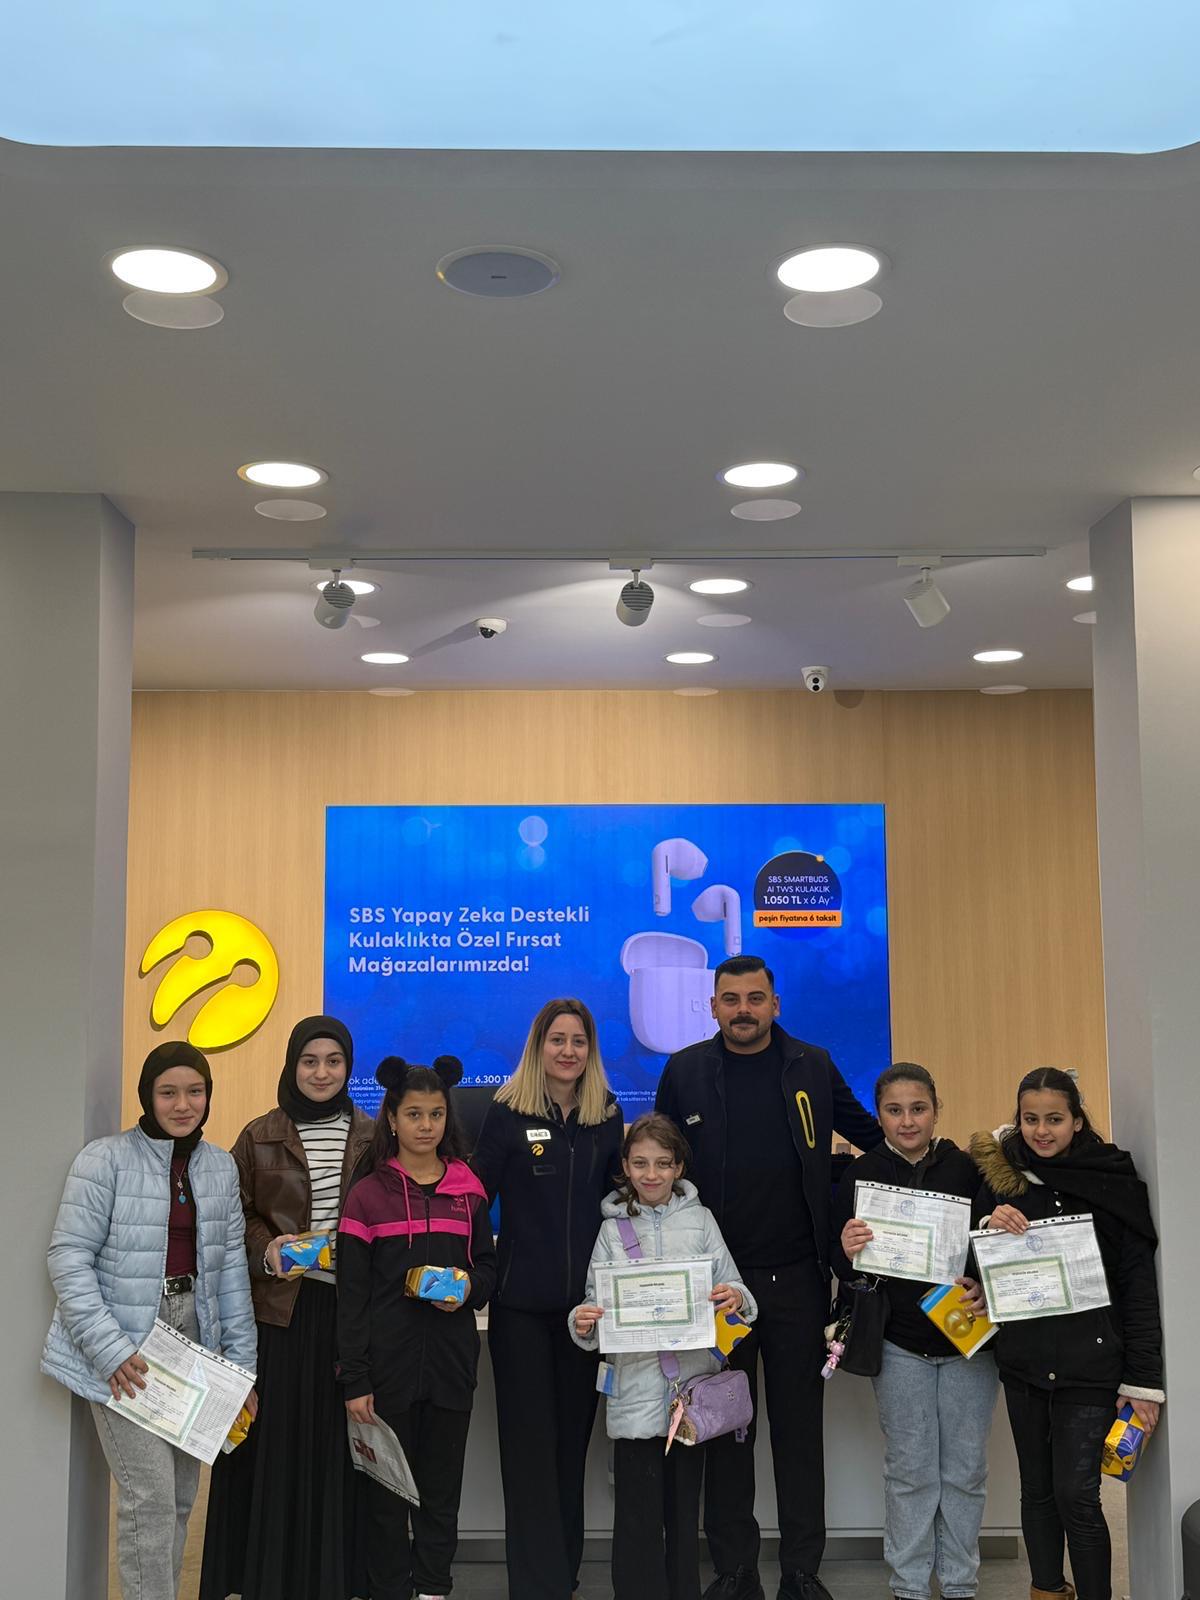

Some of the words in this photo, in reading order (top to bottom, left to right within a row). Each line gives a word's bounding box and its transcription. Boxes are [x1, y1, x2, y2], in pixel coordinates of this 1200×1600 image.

[768, 875, 782, 883] SBS
[783, 875, 829, 883] SMARTBUDS
[763, 895, 790, 905] 1.050
[791, 895, 802, 905] TL
[810, 895, 817, 905] 6
[349, 907, 385, 923] SBS
[391, 907, 453, 927] Yapay
[458, 906, 505, 923] Zeka
[511, 906, 590, 923] Destekli
[758, 914, 778, 923] peşin
[780, 914, 808, 923] fiyatına
[349, 931, 452, 948] Kulaklıkta
[456, 927, 500, 948] Özel
[506, 931, 561, 948] Fırsat
[348, 955, 530, 977] Mağazalarımızda!
[348, 1076, 361, 1085] ok
[461, 1075, 473, 1084] at:
[475, 1074, 501, 1084] 6.300
